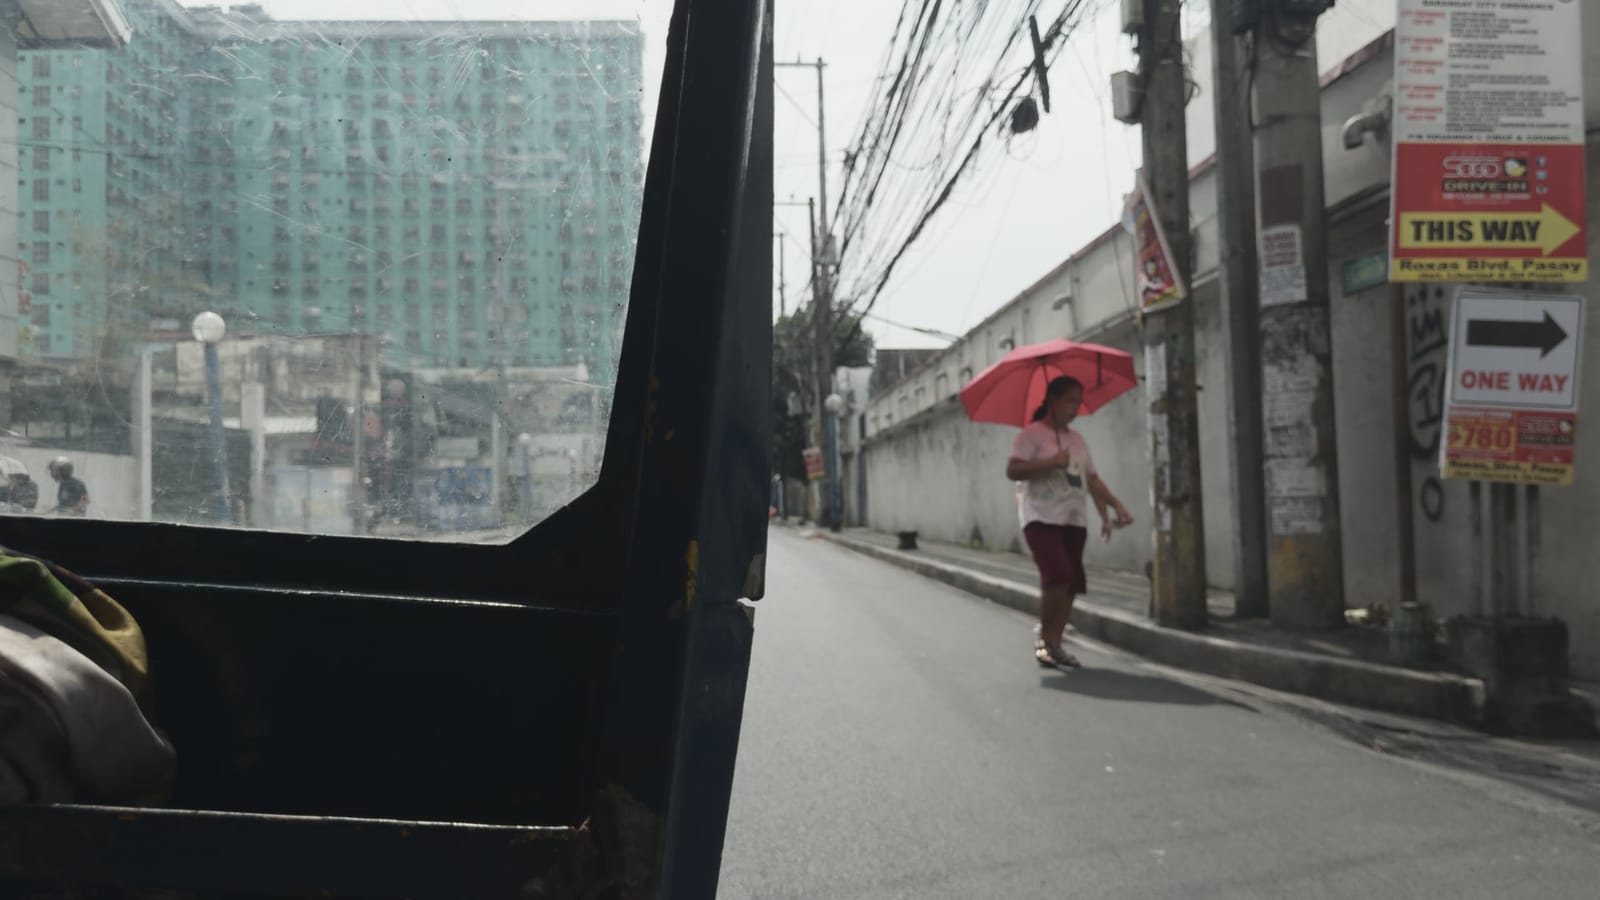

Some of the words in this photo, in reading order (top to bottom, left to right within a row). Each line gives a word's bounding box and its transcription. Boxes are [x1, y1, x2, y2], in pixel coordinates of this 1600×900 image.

[1411, 220, 1473, 242] THIS
[1480, 220, 1542, 242] WAY
[1522, 260, 1582, 272] Pasay
[1460, 371, 1510, 390] ONE
[1518, 374, 1568, 394] WAY
